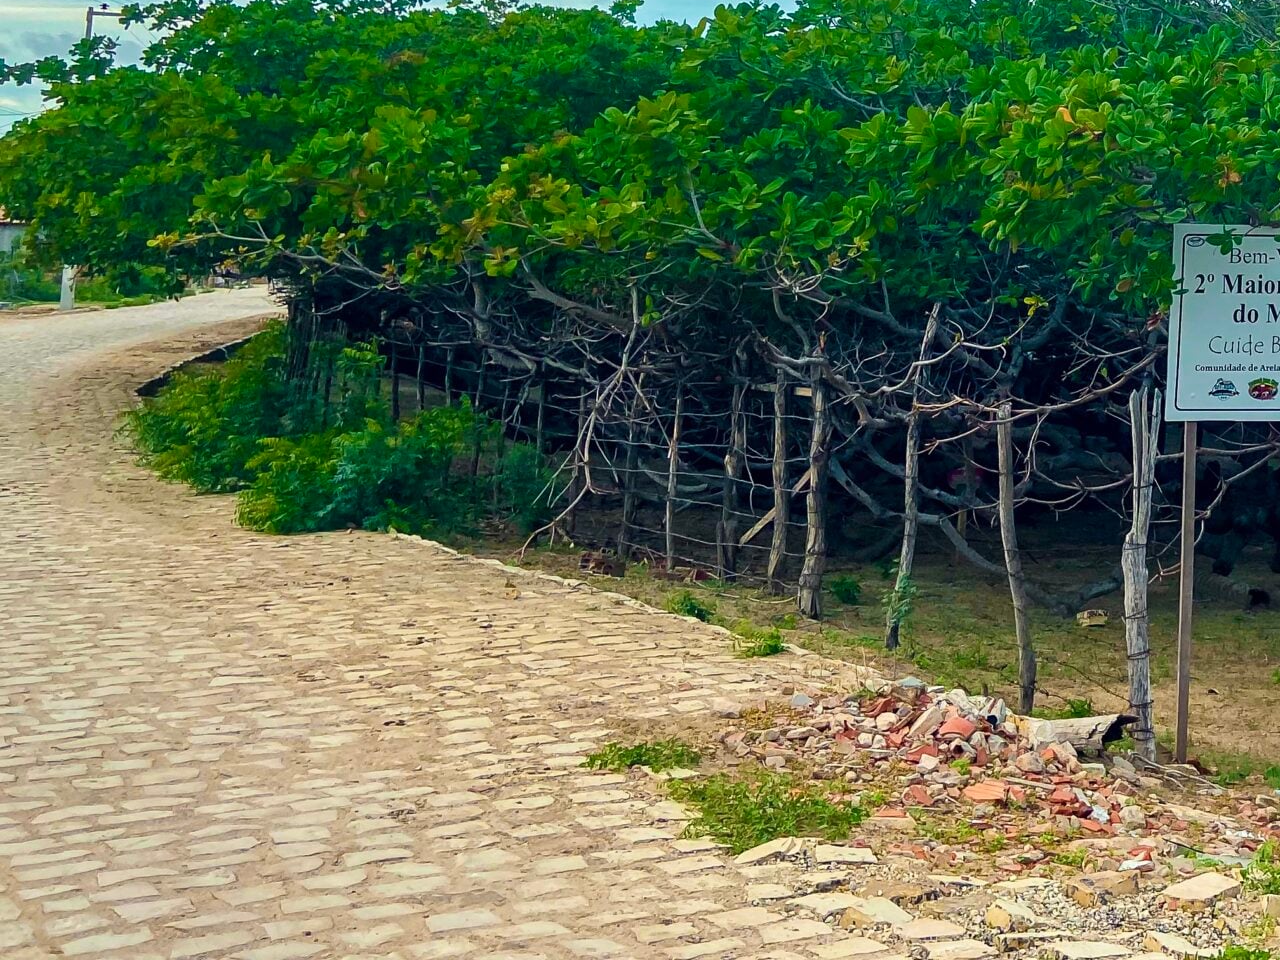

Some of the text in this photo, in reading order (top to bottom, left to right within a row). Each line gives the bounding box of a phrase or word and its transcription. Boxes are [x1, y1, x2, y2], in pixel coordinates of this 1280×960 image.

[1233, 303, 1259, 323] do
[1208, 334, 1264, 356] Cuide
[1195, 363, 1246, 372] Comunidade
[1248, 363, 1258, 372] de
